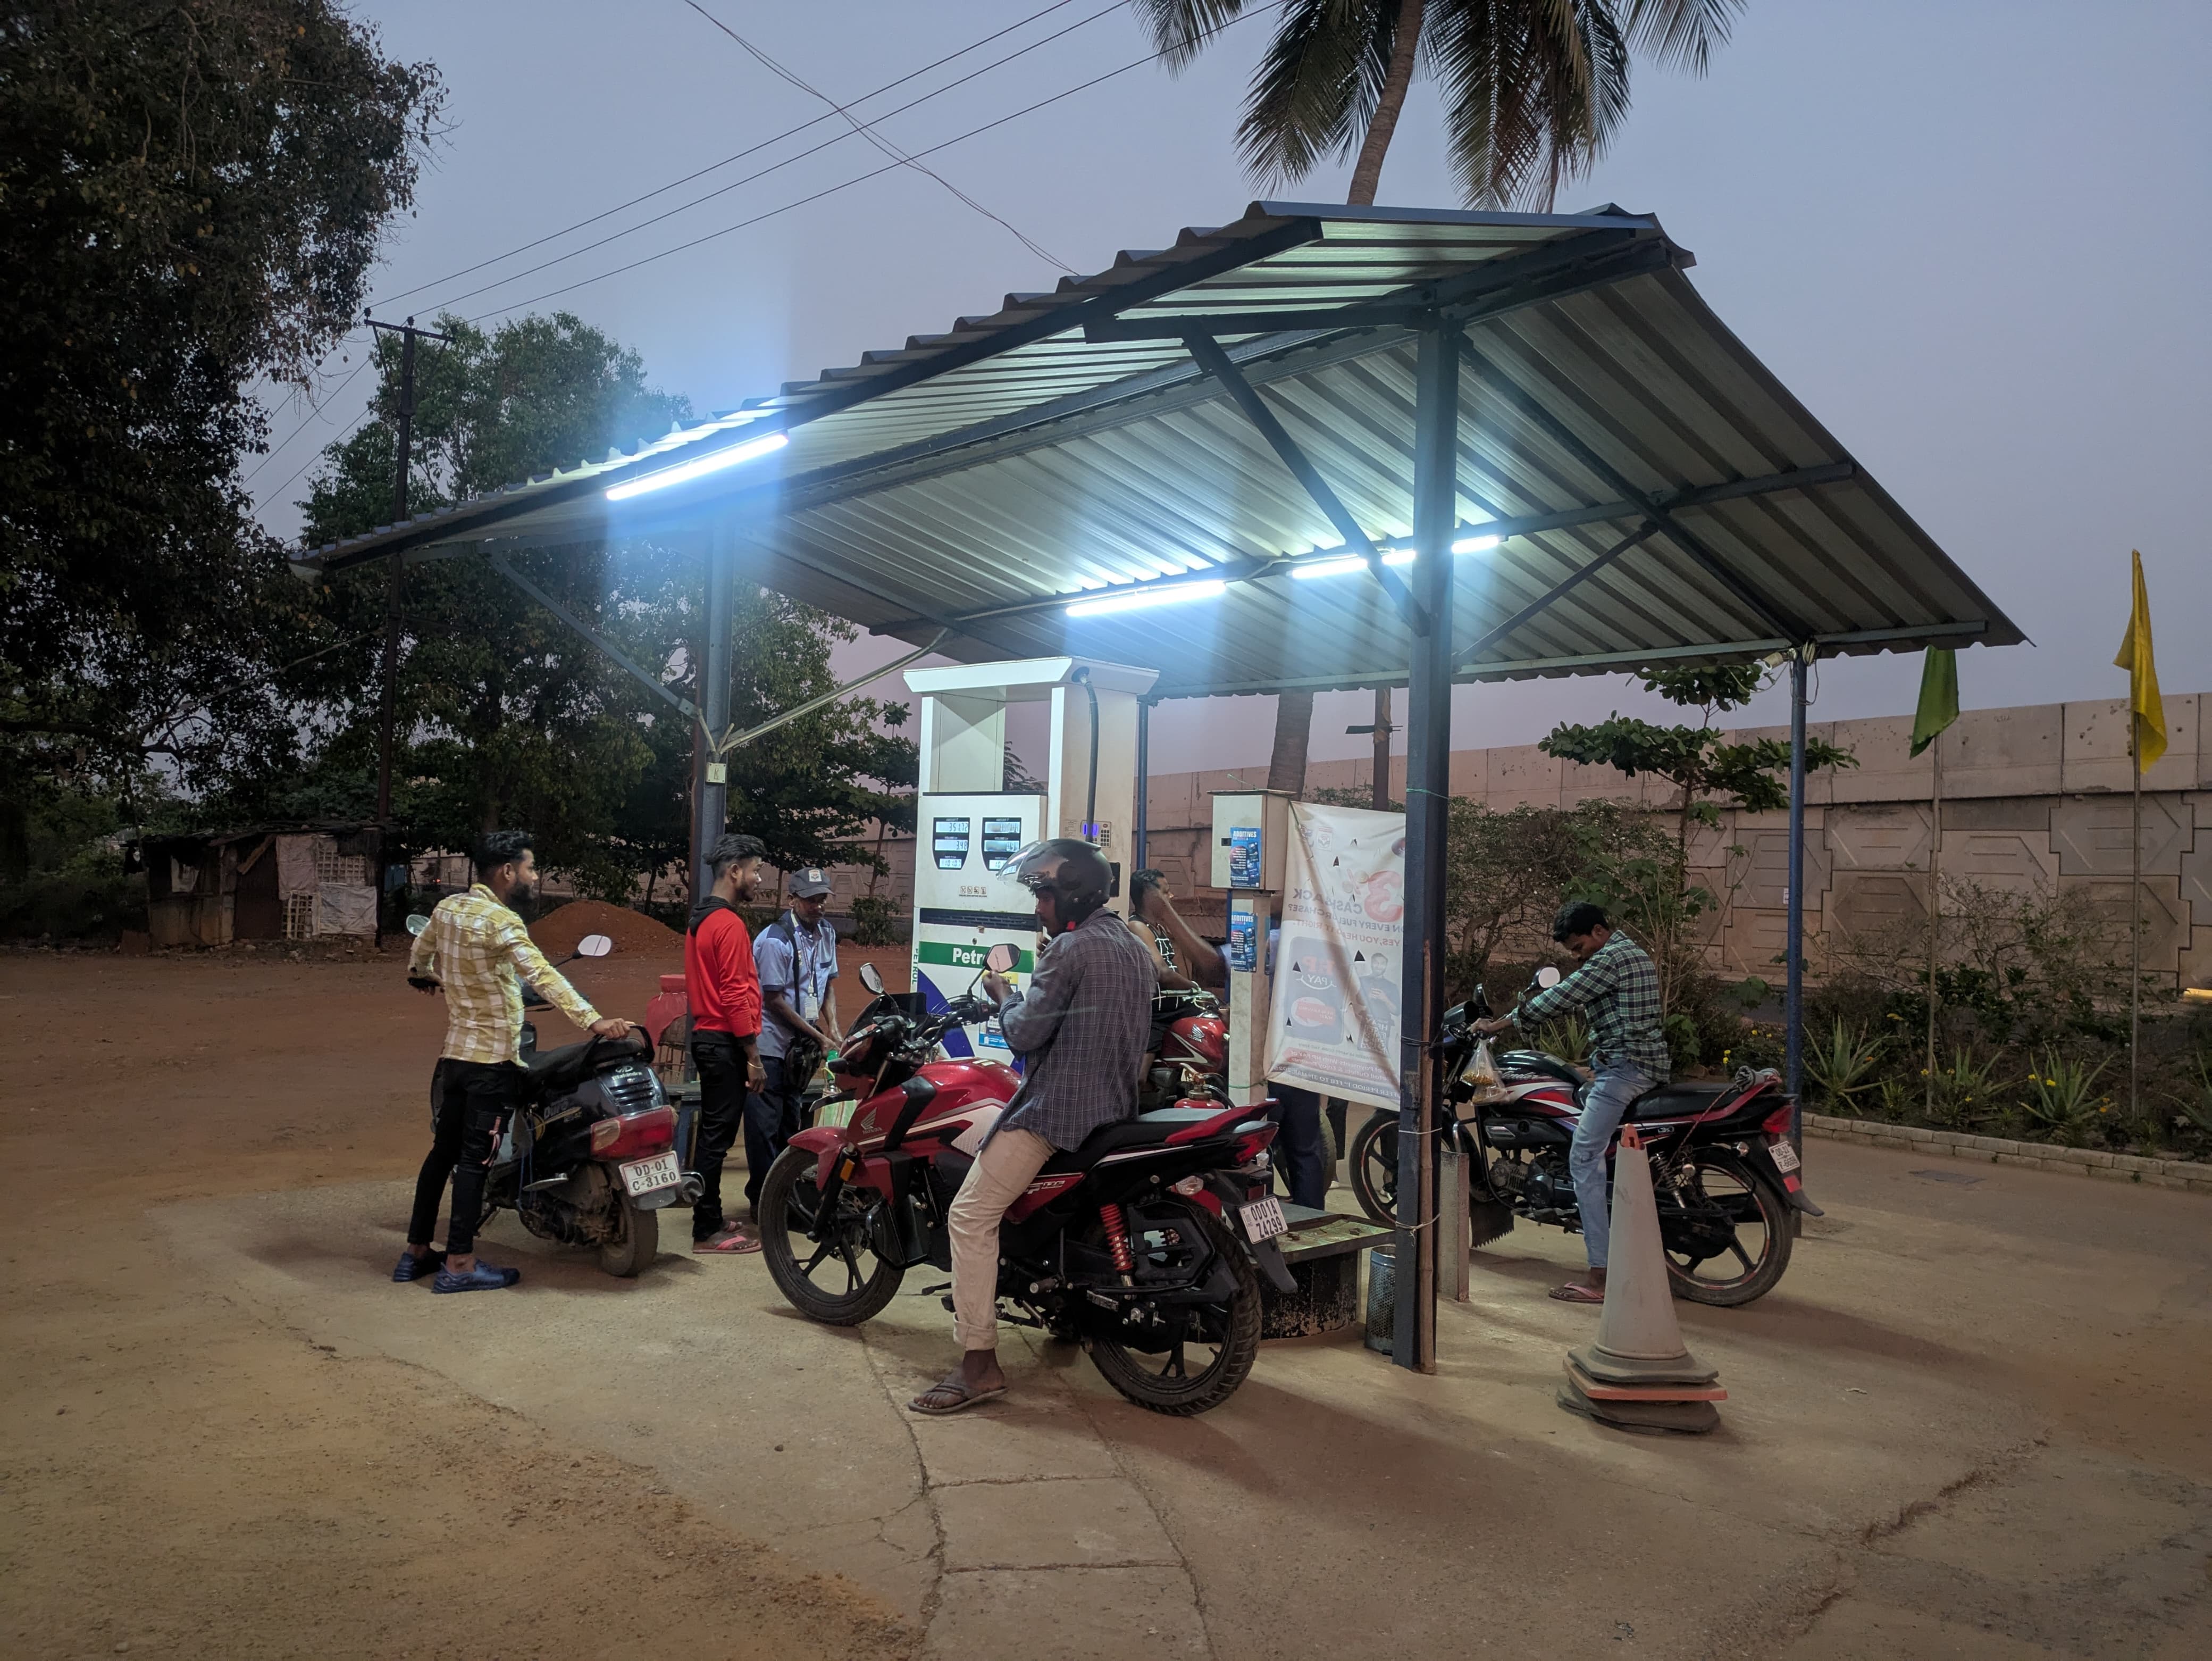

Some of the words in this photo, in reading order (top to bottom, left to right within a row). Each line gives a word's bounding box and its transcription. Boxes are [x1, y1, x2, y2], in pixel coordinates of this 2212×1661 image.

[952, 947, 985, 965] Petr
[1025, 1180, 1066, 1195] P125
[1250, 1199, 1278, 1221] OD01A
[1255, 1216, 1283, 1239] Z4299
